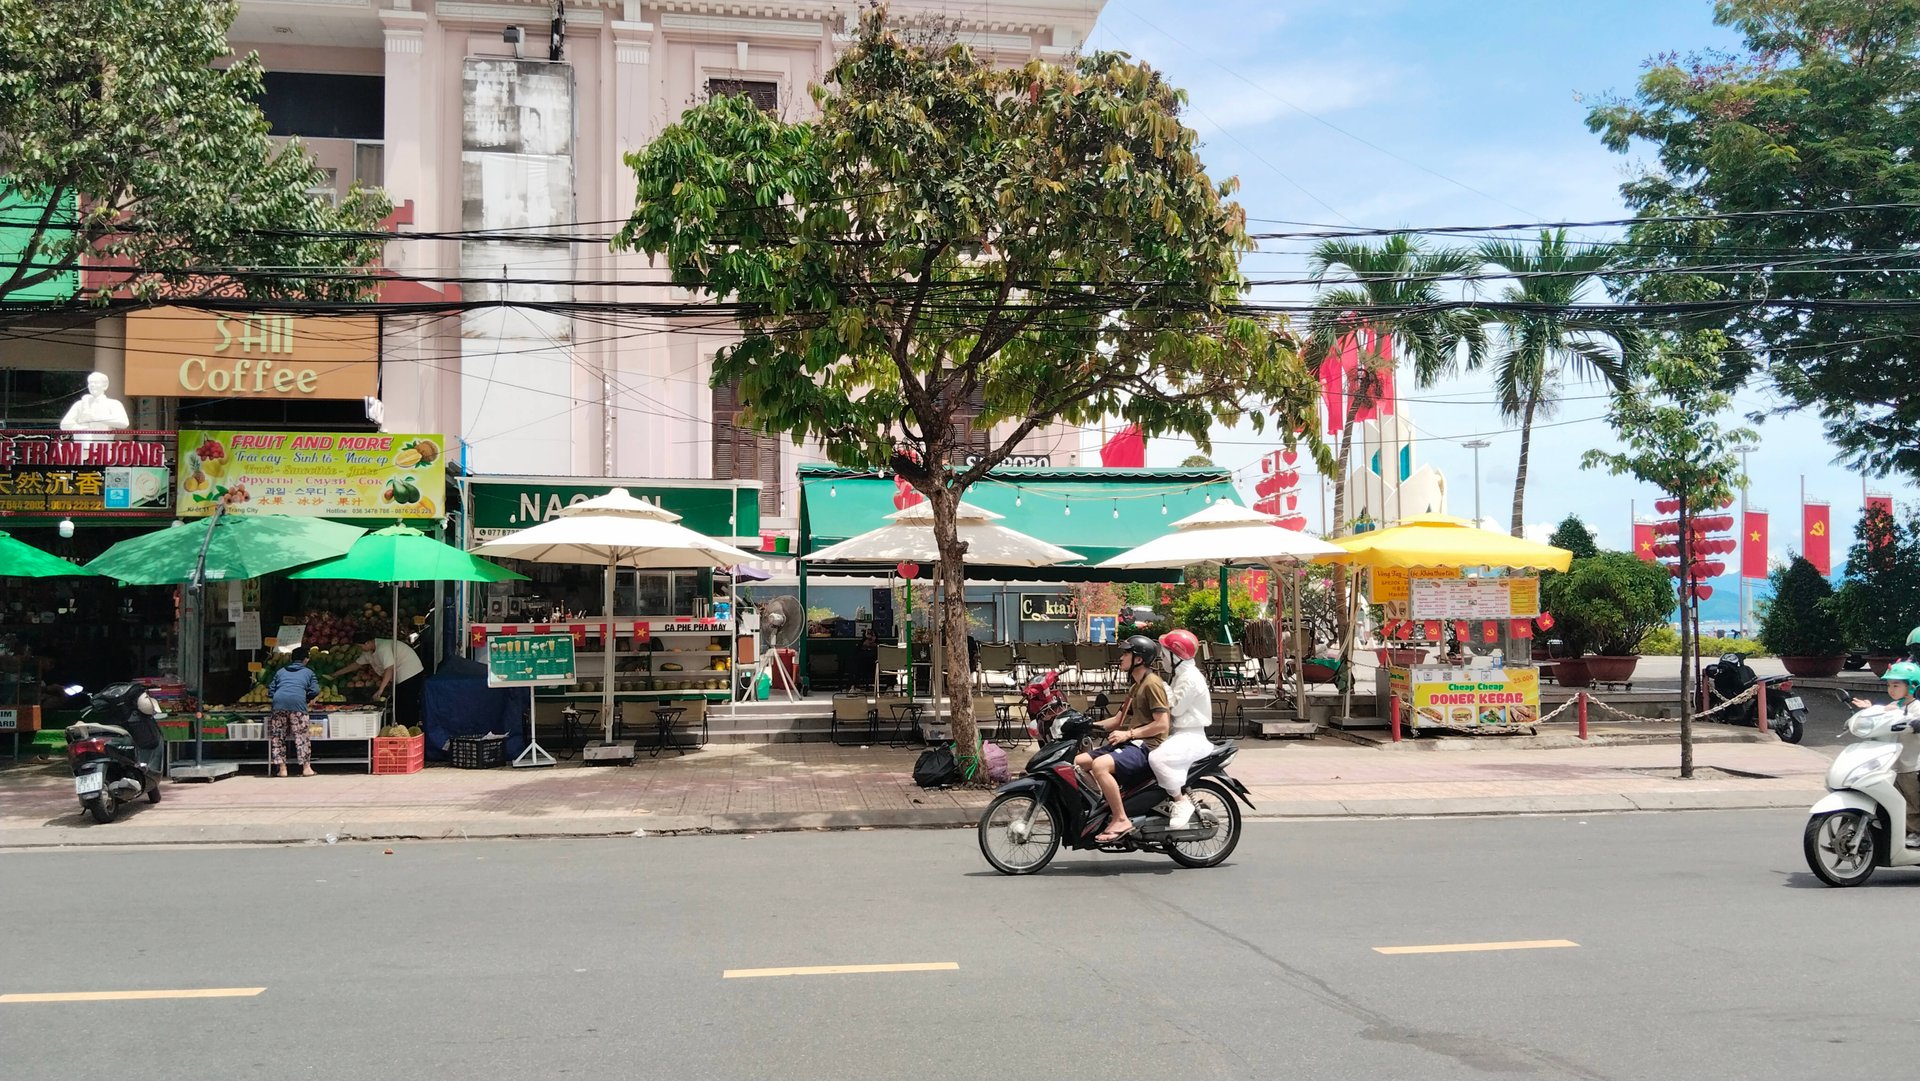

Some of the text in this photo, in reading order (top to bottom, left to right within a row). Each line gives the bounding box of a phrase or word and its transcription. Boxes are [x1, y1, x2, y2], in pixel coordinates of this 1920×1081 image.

[179, 358, 318, 393] Coffee
[231, 434, 394, 451] FRUIT AND MORE
[87, 440, 165, 467] HƯƠNG
[293, 452, 317, 463] Sinh
[240, 475, 383, 486] Фрукты Смузи Сок
[265, 487, 357, 496] 과일 스무디 주스
[259, 497, 363, 506] 水果 冰沙 果汁
[246, 506, 259, 514] City
[693, 623, 709, 632] PHA
[1448, 682, 1504, 692] Cheap Cheap
[1430, 692, 1524, 705] DONER KEBAB
